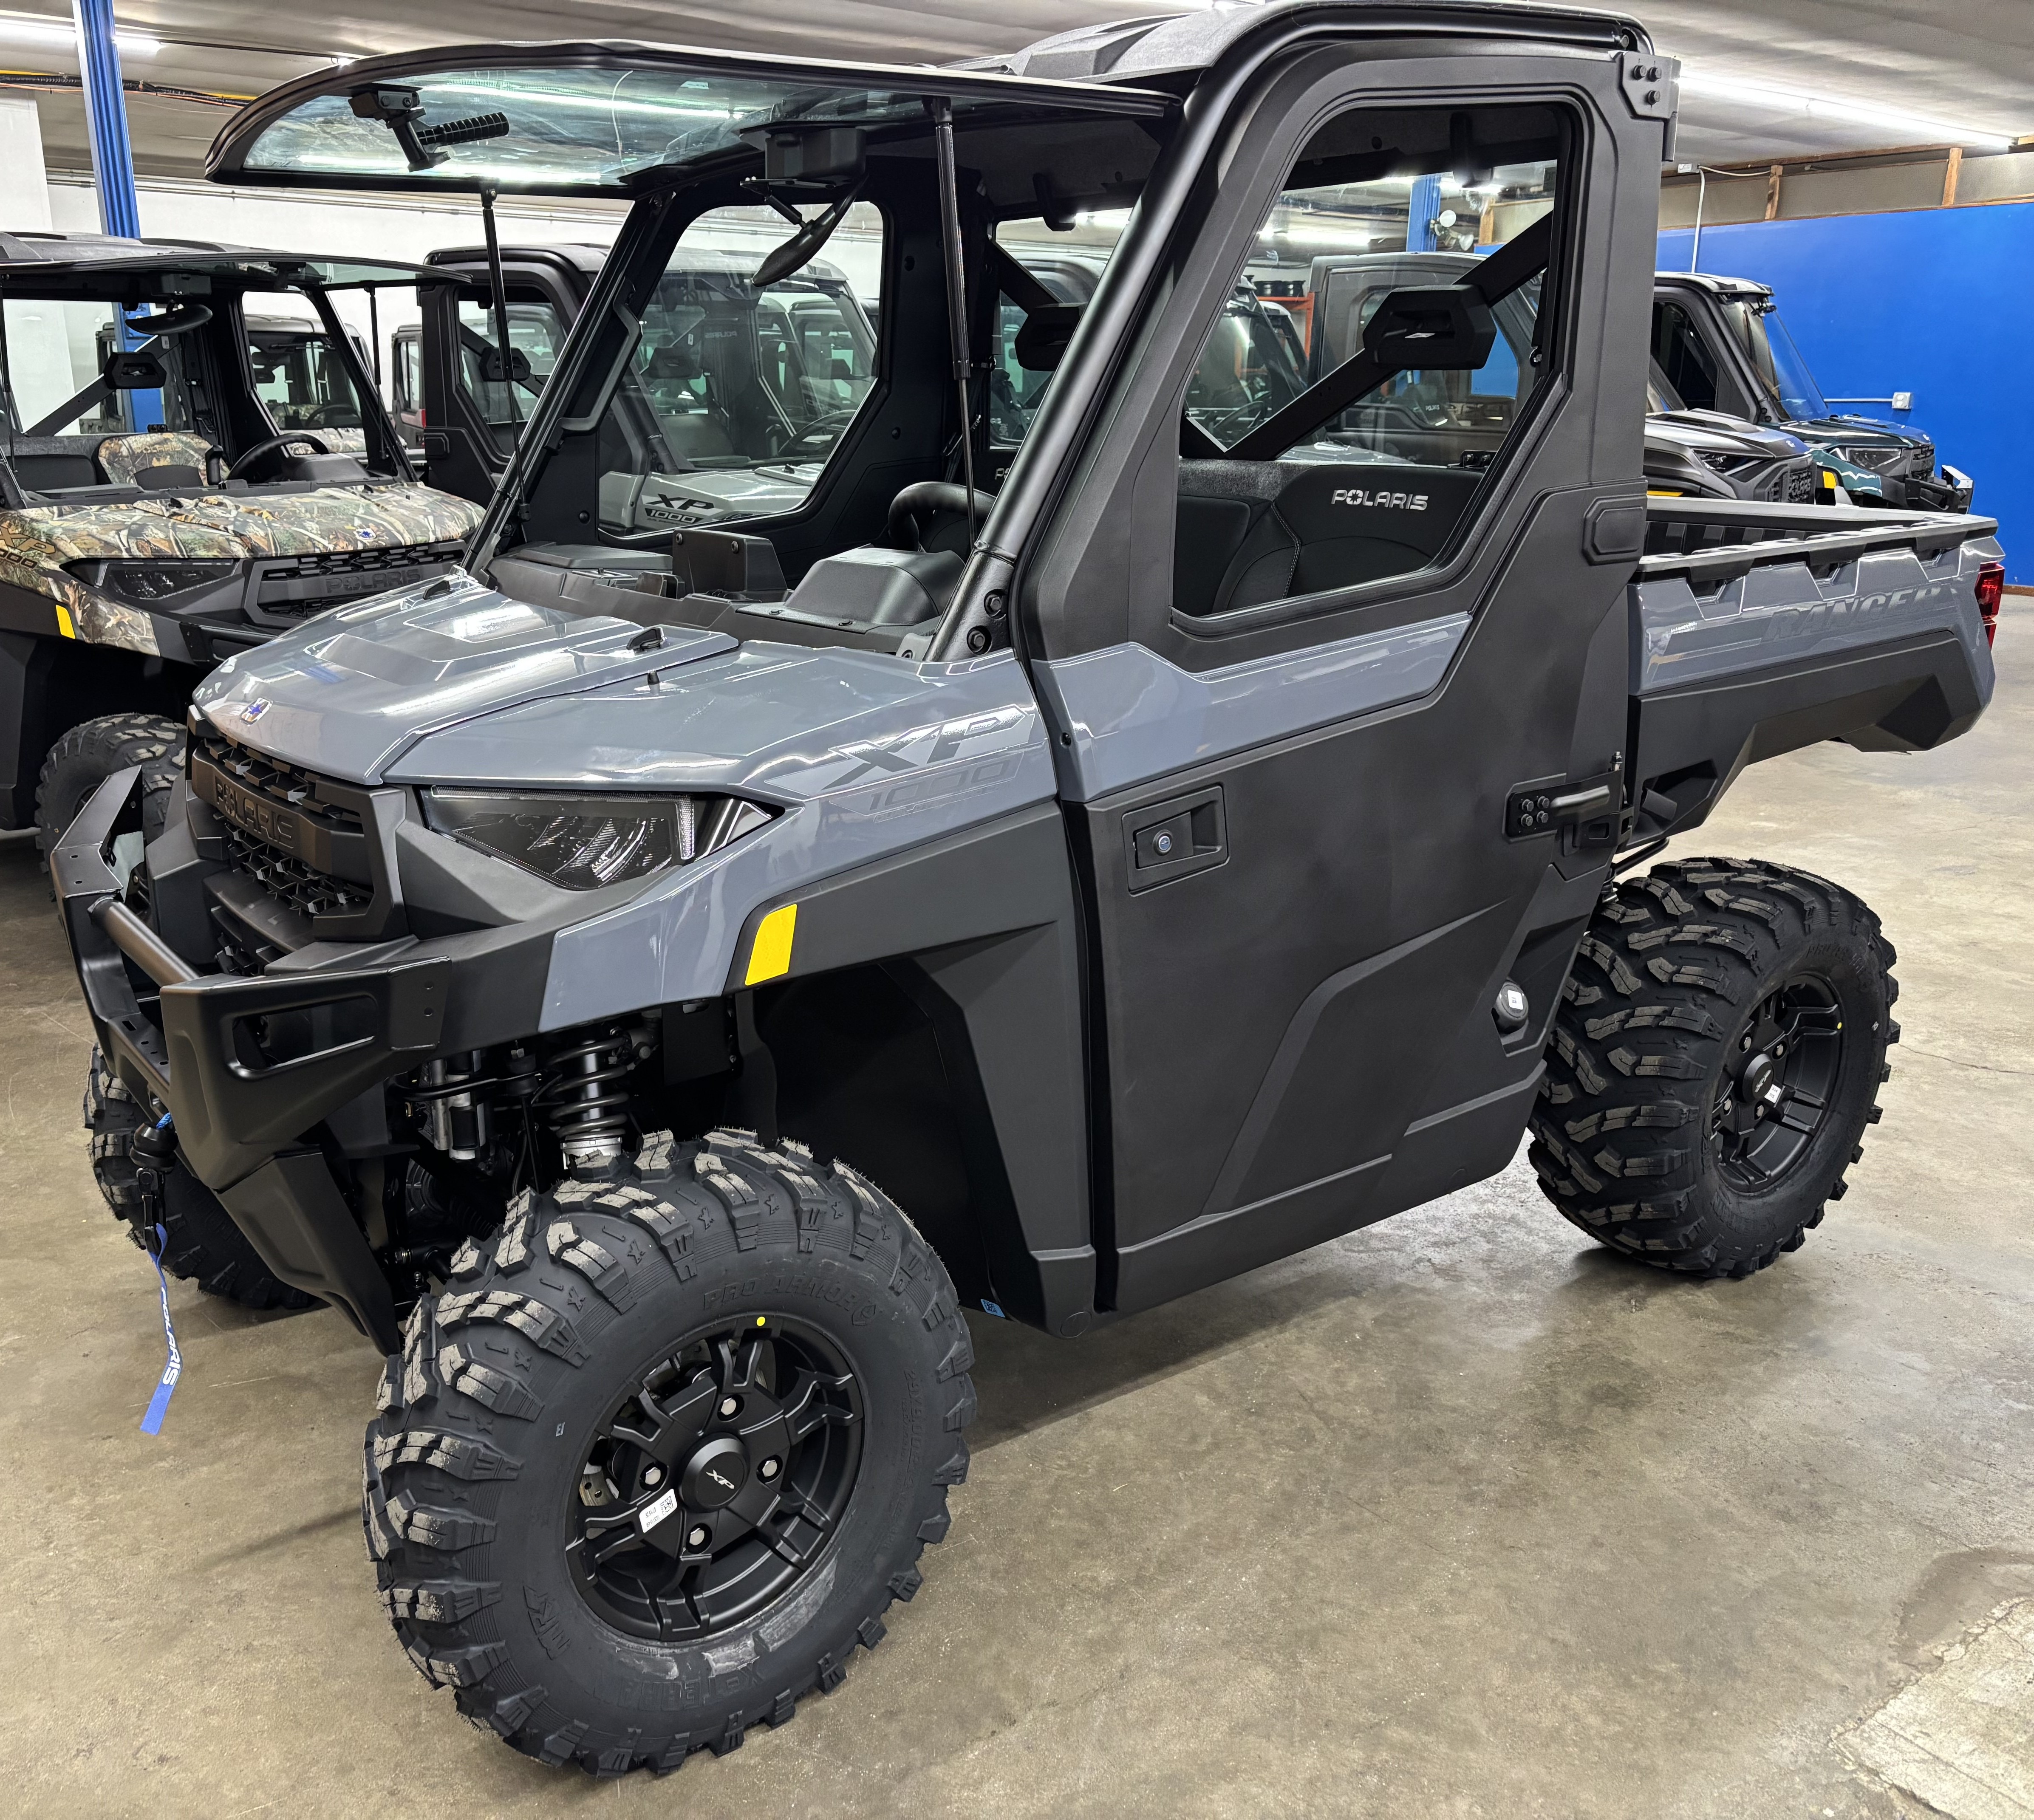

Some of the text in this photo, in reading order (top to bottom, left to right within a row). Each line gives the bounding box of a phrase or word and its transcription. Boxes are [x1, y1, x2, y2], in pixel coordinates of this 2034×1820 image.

[645, 493, 714, 510] XP
[1331, 489, 1429, 510] POLARIS
[650, 510, 696, 523] 1000
[0, 526, 56, 554] XP
[325, 568, 421, 593] POLARIS
[820, 705, 1027, 791] XP
[869, 757, 1011, 811] 1000
[214, 775, 294, 849] POLARIS
[161, 1286, 181, 1385] POLARIS
[705, 1469, 735, 1489] XP
